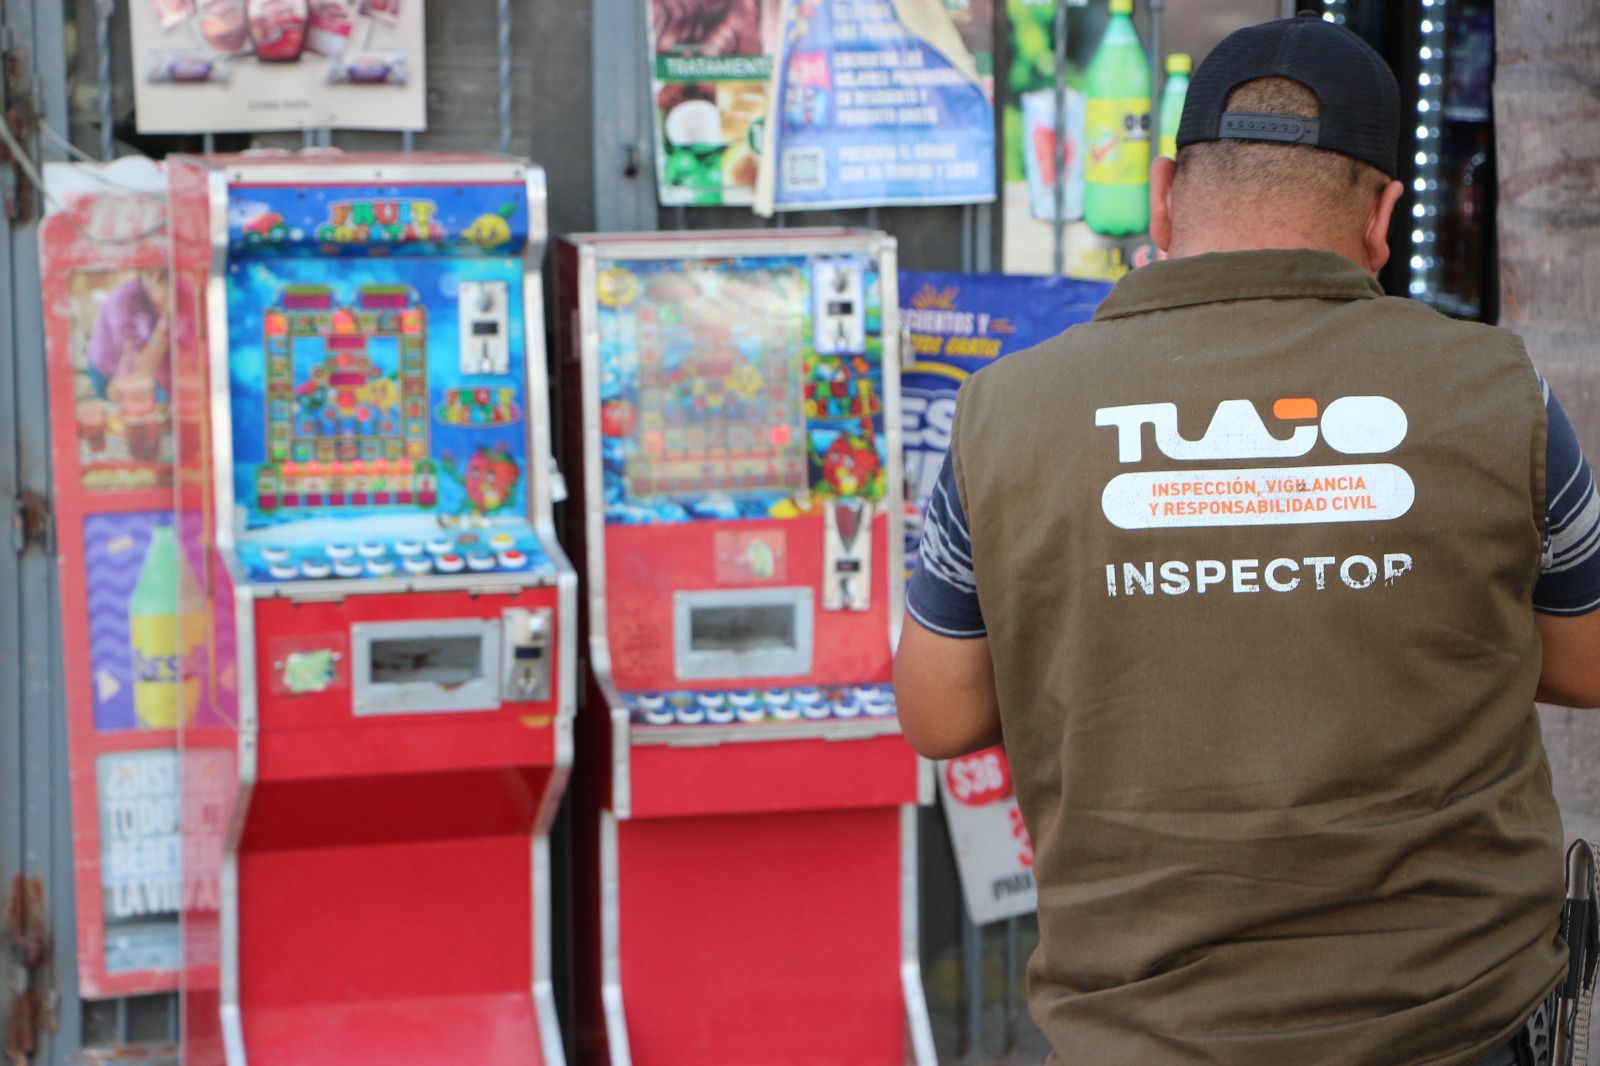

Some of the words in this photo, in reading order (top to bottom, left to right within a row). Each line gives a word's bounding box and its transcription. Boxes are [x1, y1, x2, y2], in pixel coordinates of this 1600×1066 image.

[1151, 476, 1262, 498] INSPECCIÓN,
[1266, 475, 1367, 493] VIGILANCIA
[1148, 502, 1160, 517] Y
[1163, 497, 1328, 516] RESPONSABILIDAD
[1331, 494, 1378, 511] CIVIL
